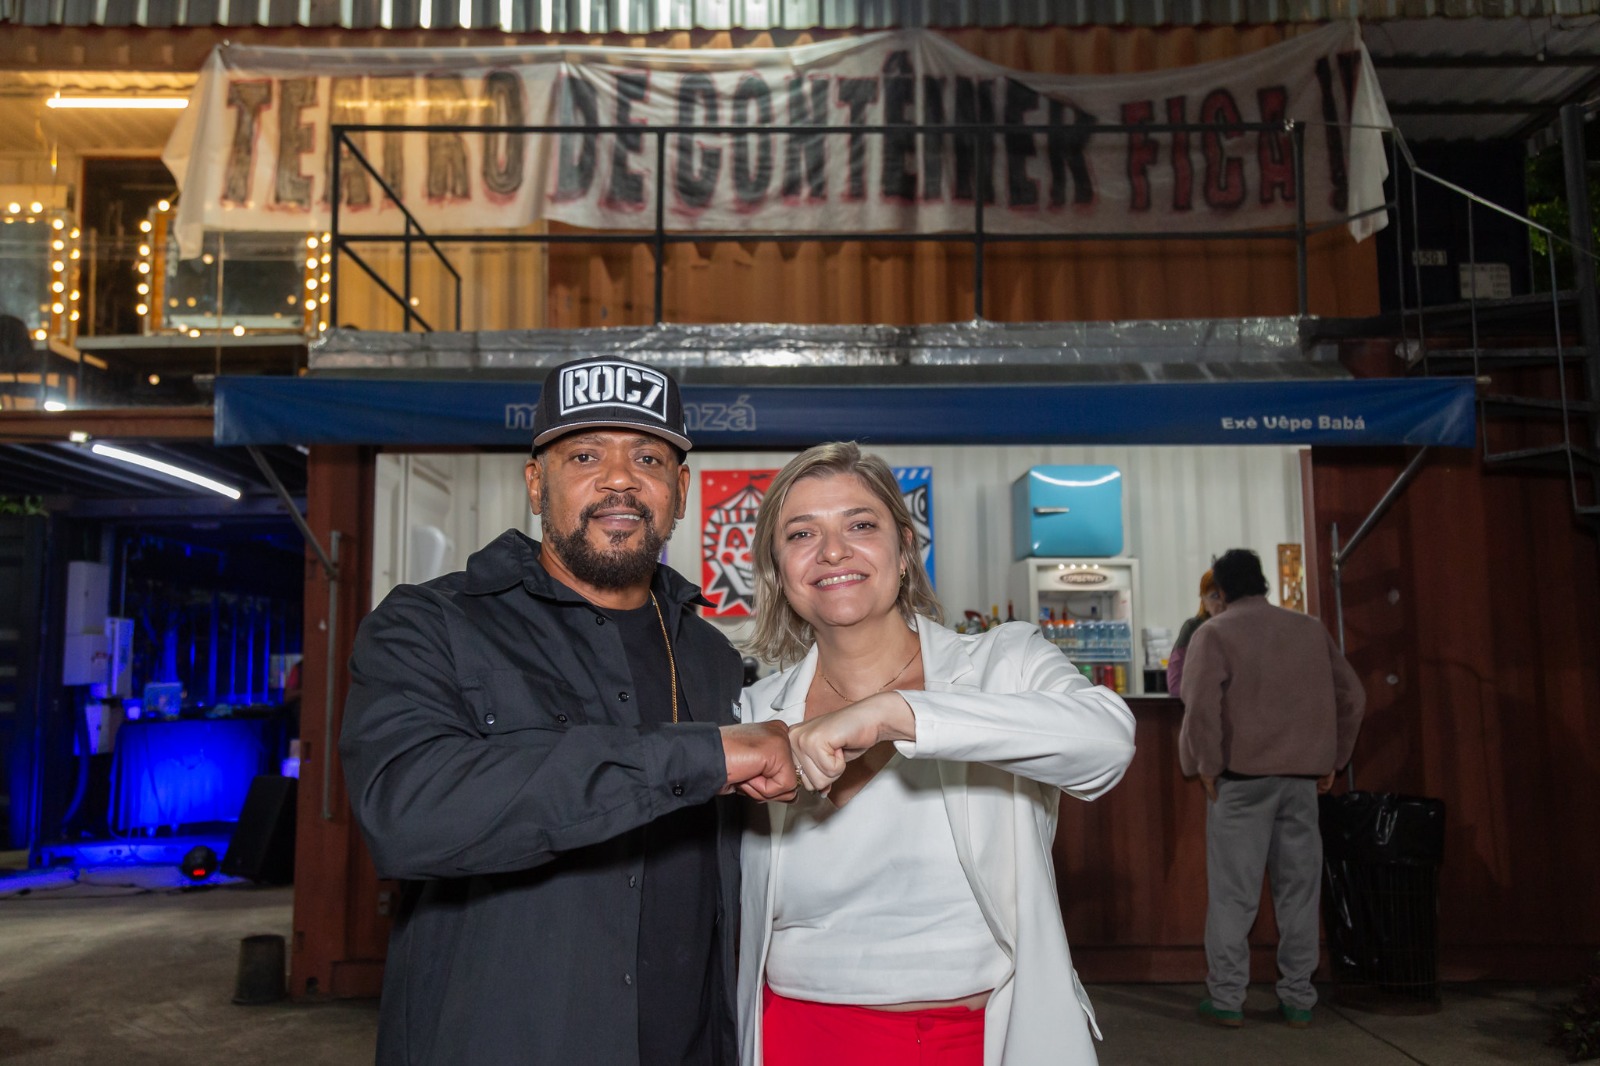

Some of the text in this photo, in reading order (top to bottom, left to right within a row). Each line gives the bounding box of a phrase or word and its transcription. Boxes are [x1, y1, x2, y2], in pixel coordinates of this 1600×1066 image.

[220, 67, 528, 211] TEATRO
[547, 68, 650, 213] DE
[564, 366, 665, 408] ROC7
[1221, 415, 1366, 433] Exê Uêpe Babá
